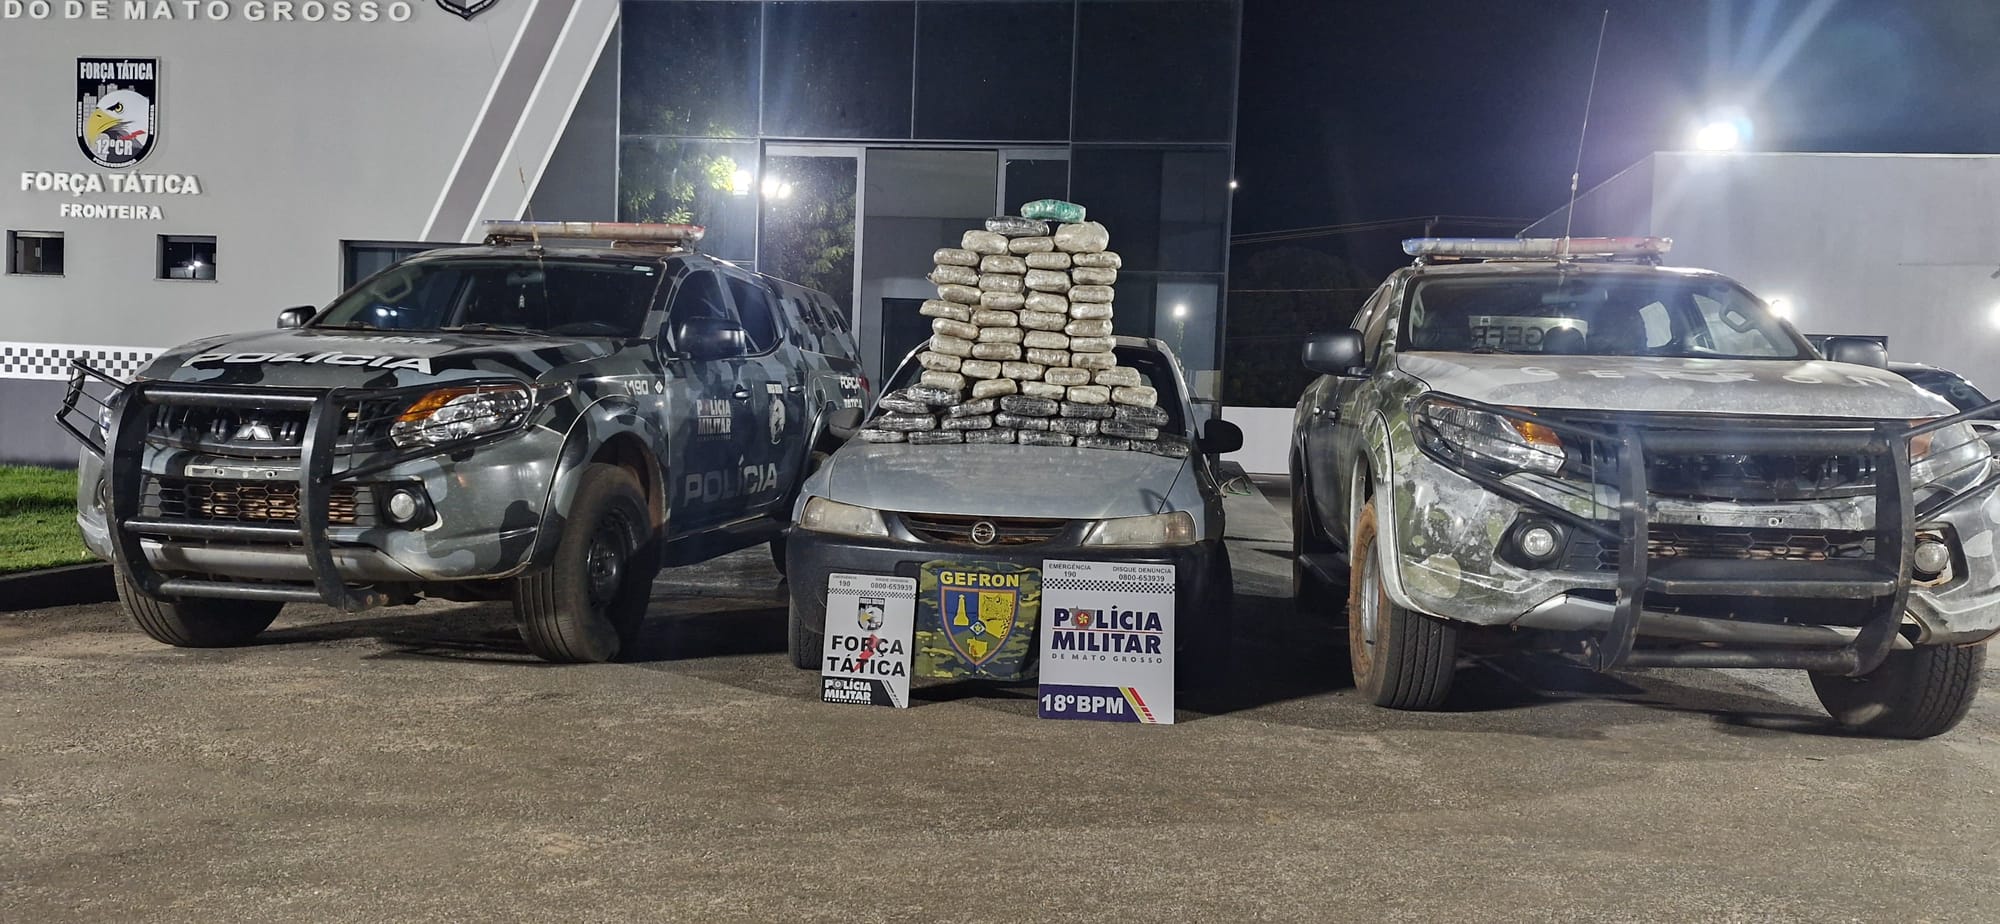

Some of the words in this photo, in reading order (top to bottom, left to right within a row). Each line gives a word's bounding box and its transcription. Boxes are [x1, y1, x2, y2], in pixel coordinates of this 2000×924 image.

[4, 0, 50, 19] DO
[64, 0, 109, 20] DE
[124, 0, 230, 20] MATO
[243, 0, 411, 22] GROSSO
[80, 62, 115, 83] FORÇA
[116, 60, 154, 80] TÁTICA
[21, 172, 102, 197] FORÇA
[109, 169, 200, 195] TÁTICA
[60, 203, 163, 220] FRONTEIRA
[697, 418, 731, 434] MILITAR
[684, 454, 778, 505] POLÍCIA
[940, 571, 1019, 587] GEFRON
[1118, 573, 1165, 582] 0800-653939
[831, 635, 904, 657] FORÇA
[1051, 631, 1162, 655] MILITAR
[827, 653, 906, 677] TÁTICA
[1071, 654, 1106, 662] MATO
[1112, 655, 1163, 664] GROSSO
[823, 689, 872, 701] MILITAR
